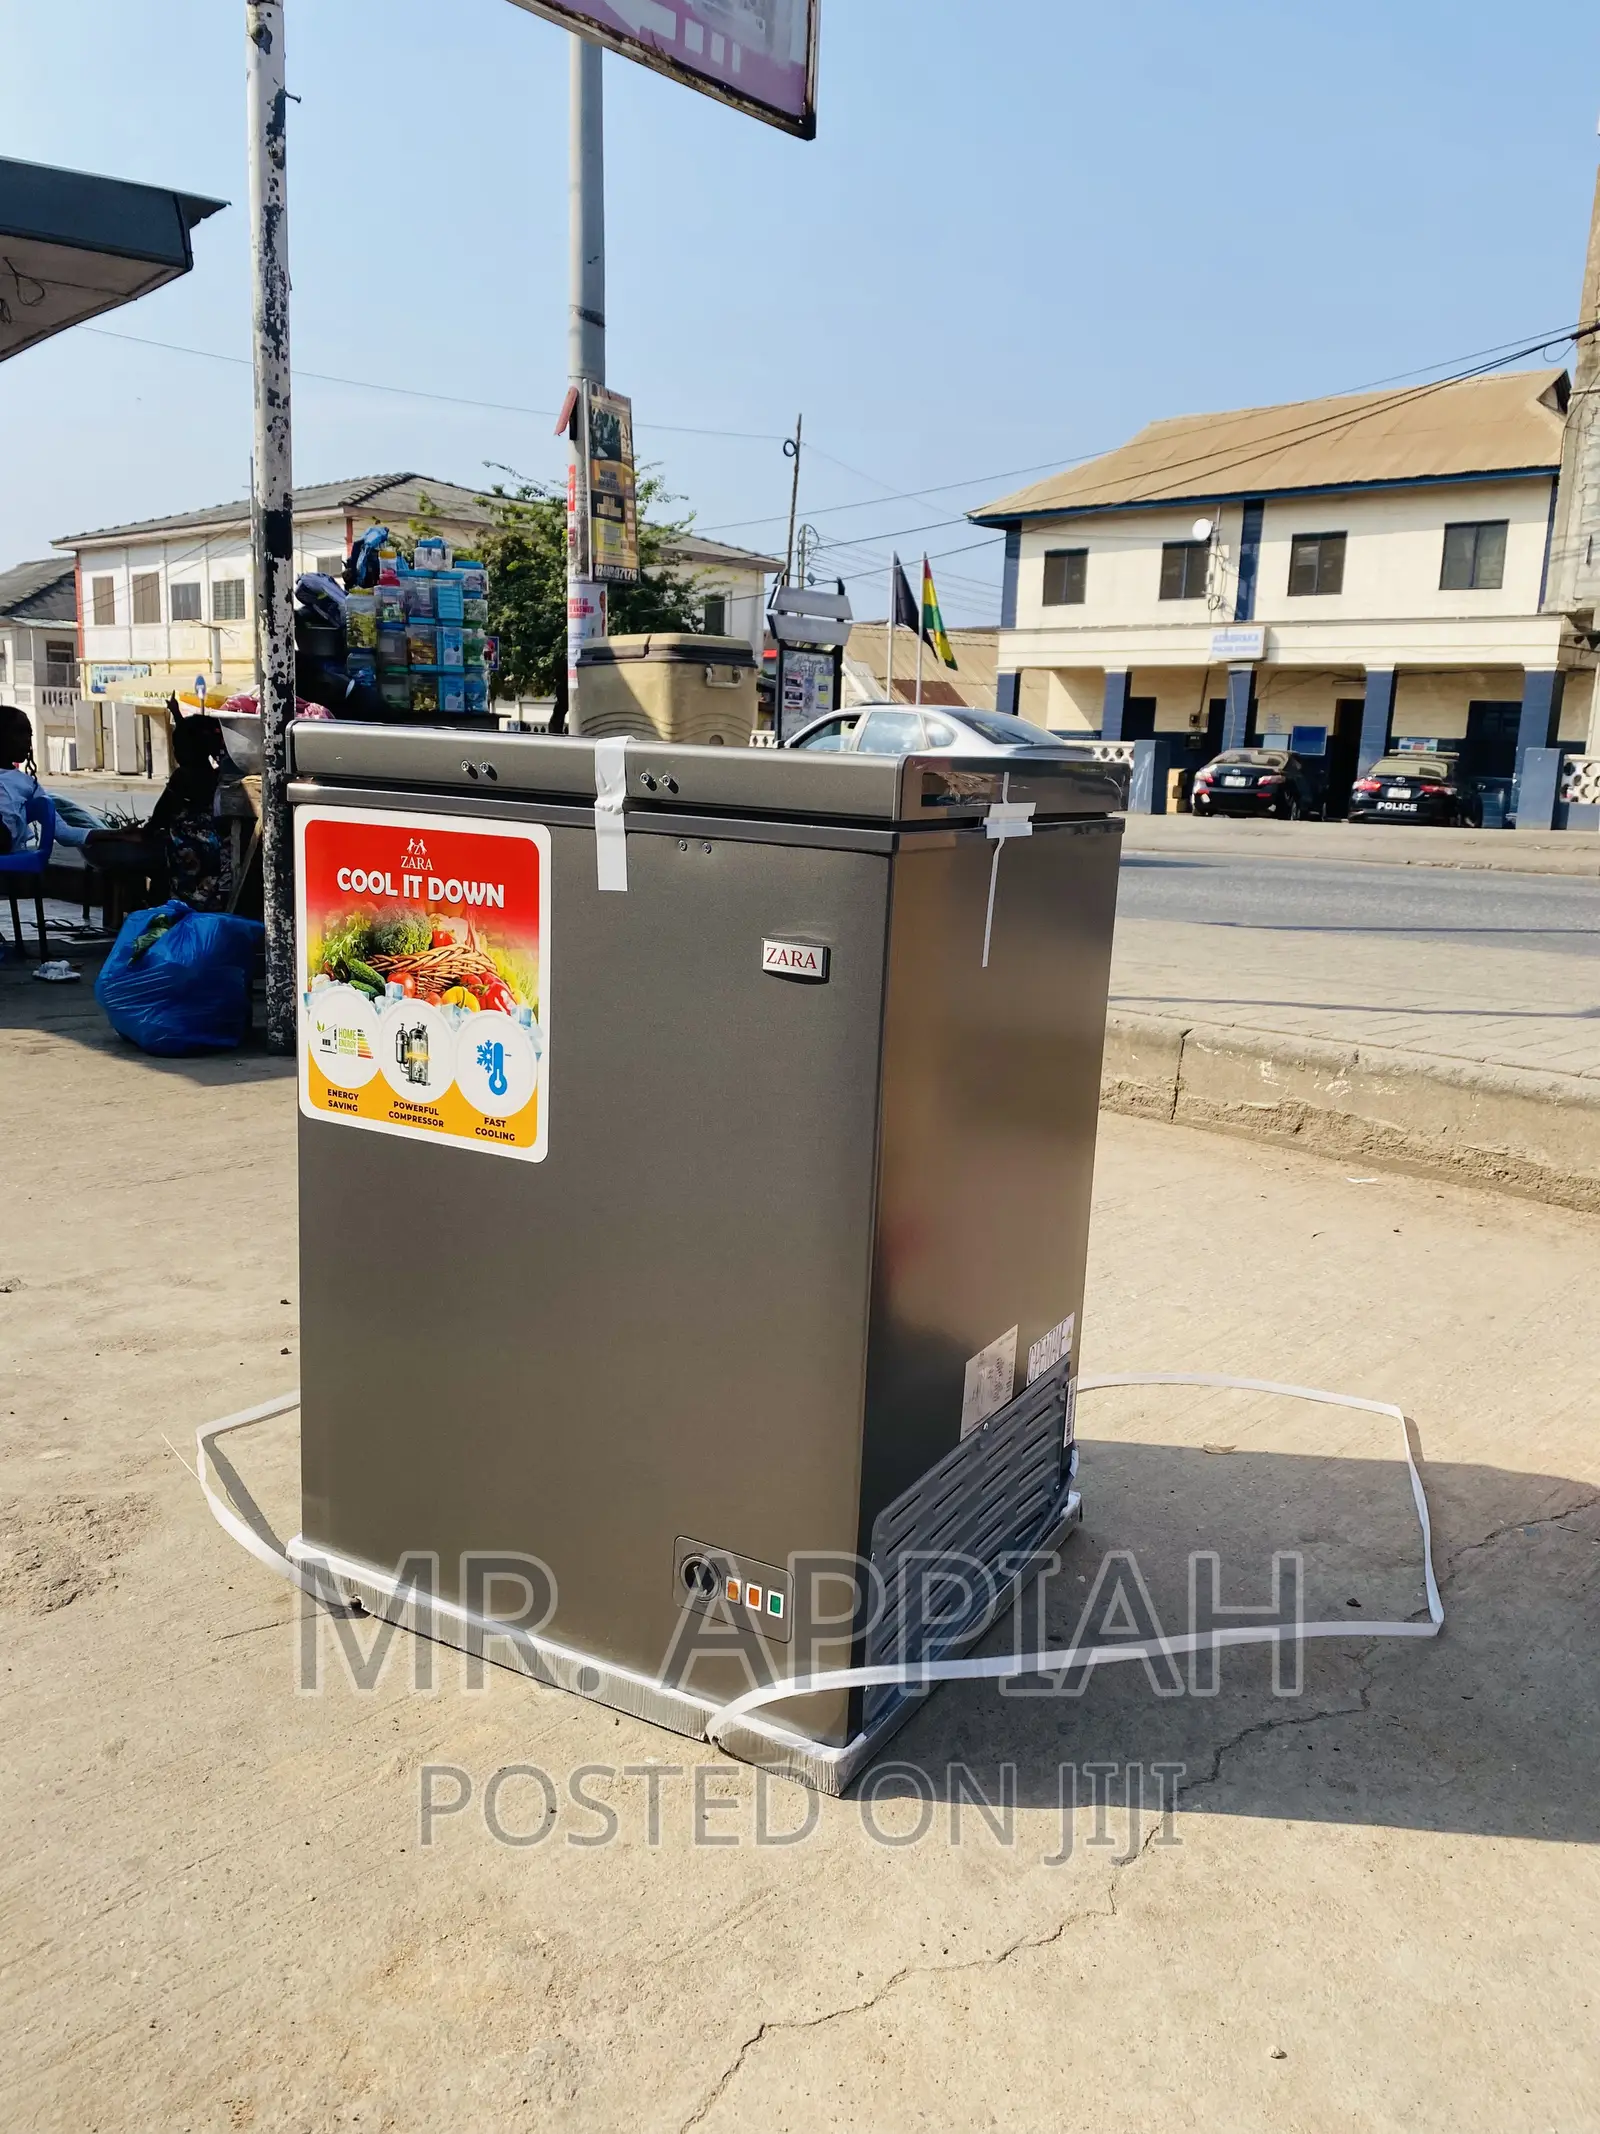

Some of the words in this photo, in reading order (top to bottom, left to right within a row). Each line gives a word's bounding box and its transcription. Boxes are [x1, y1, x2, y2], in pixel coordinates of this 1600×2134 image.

[1377, 801, 1418, 812] POLICE
[400, 855, 434, 871] ZARA
[336, 867, 399, 897] COOL
[403, 874, 423, 898] IT
[427, 876, 505, 909] DOWN
[765, 946, 818, 970] ZARA
[338, 1027, 357, 1041] HOME
[327, 1088, 360, 1101] ENERGY
[327, 1099, 359, 1112] SAVING
[393, 1100, 440, 1116] POWERFUL
[388, 1110, 445, 1128] COMPRESSOR
[483, 1117, 507, 1128] FAST
[475, 1127, 516, 1141] COOLING
